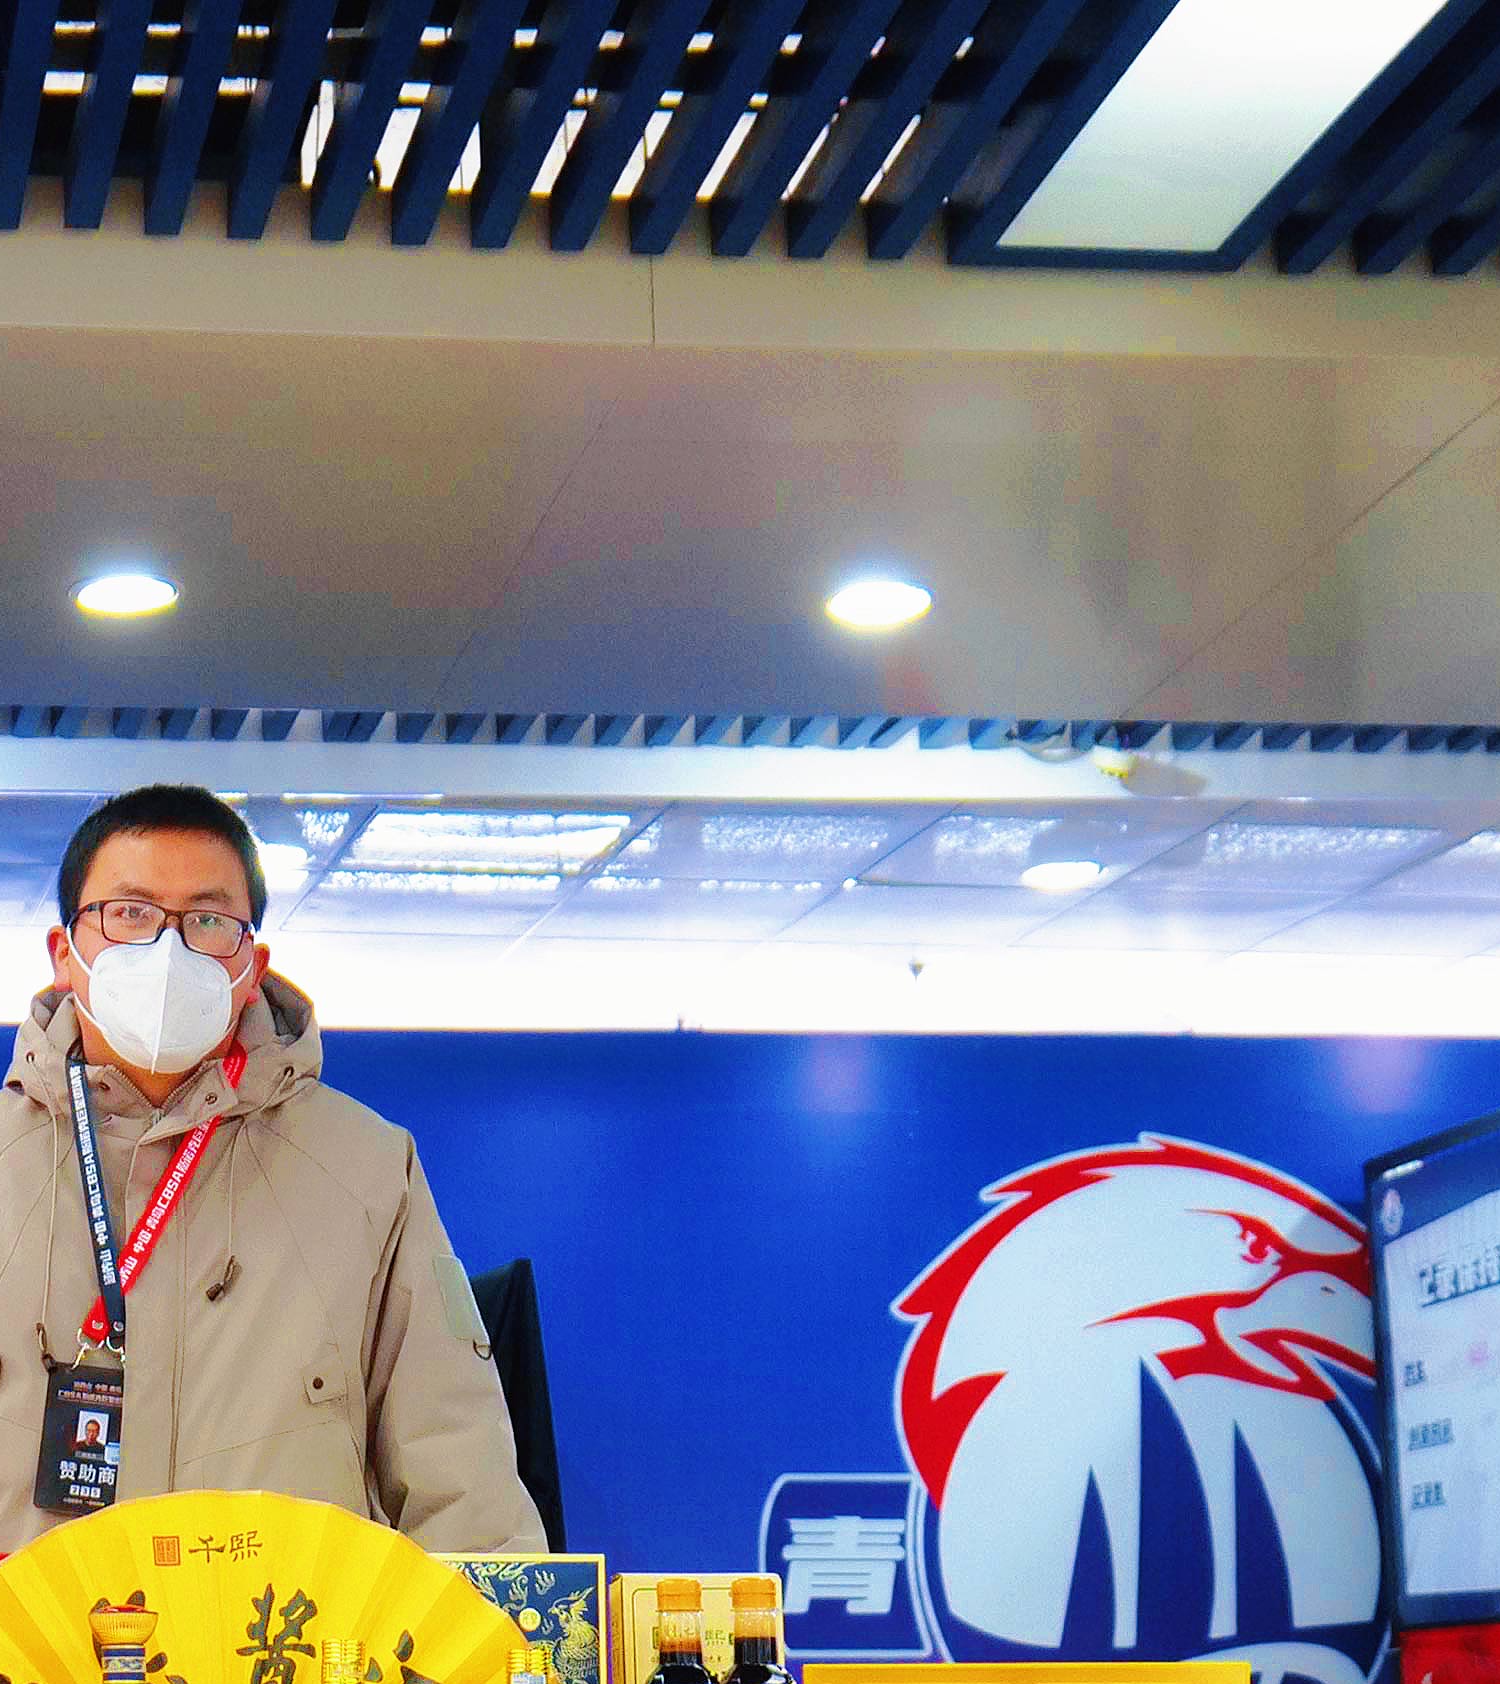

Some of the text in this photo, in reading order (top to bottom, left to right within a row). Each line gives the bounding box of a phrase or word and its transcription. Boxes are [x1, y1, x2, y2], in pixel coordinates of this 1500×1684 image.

[59, 1460, 116, 1485] 赞助商
[187, 1530, 264, 1564] 千熙
[782, 1516, 906, 1614] 青
